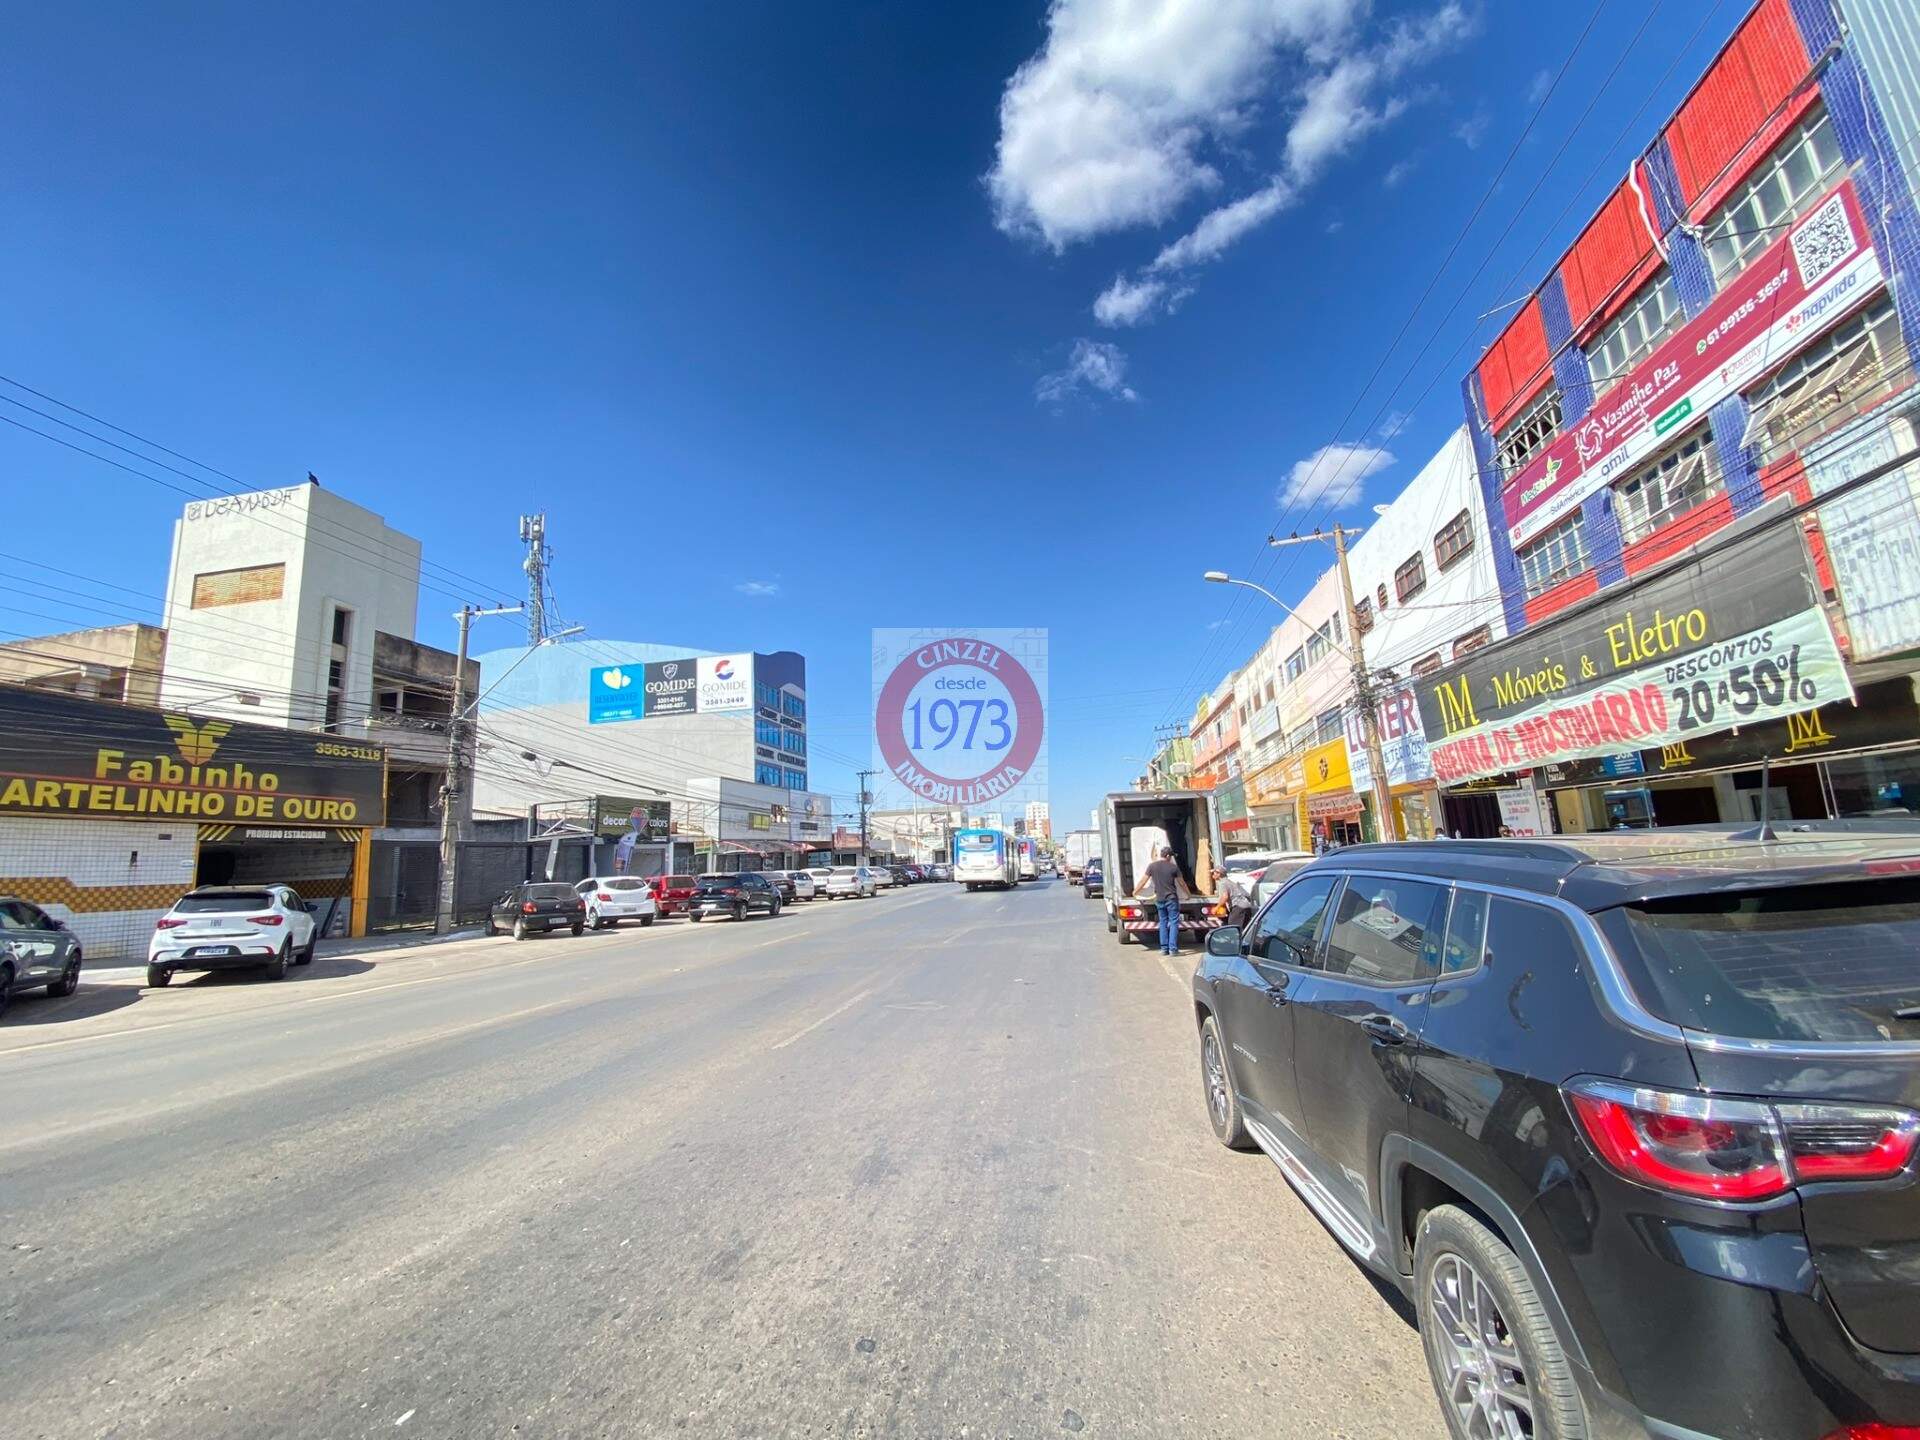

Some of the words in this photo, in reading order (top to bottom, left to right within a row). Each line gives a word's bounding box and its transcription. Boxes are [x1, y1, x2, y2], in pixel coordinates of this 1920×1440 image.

[1800, 272, 1857, 323] hapvida
[1653, 360, 1679, 387] Paz
[1601, 445, 1630, 476] amil
[1434, 674, 1480, 736] JM
[1491, 657, 1567, 709] Móveis
[1581, 655, 1598, 678] &
[1604, 608, 1706, 668] Eletro
[1665, 631, 1773, 684] DESCONTOS
[645, 678, 696, 693] GOMIDE
[1492, 727, 1521, 765] DE
[1672, 680, 1715, 731] 20
[1718, 681, 1731, 705] A
[1729, 644, 1817, 715] 50%
[1785, 707, 1827, 752] JM
[96, 748, 279, 792] Fabinho
[235, 794, 275, 818] DE
[283, 798, 357, 821] OURO
[603, 815, 628, 826] decor
[649, 817, 668, 828] colors
[245, 829, 282, 838] PROIBIDO
[283, 830, 327, 839] ESTACIONAR
